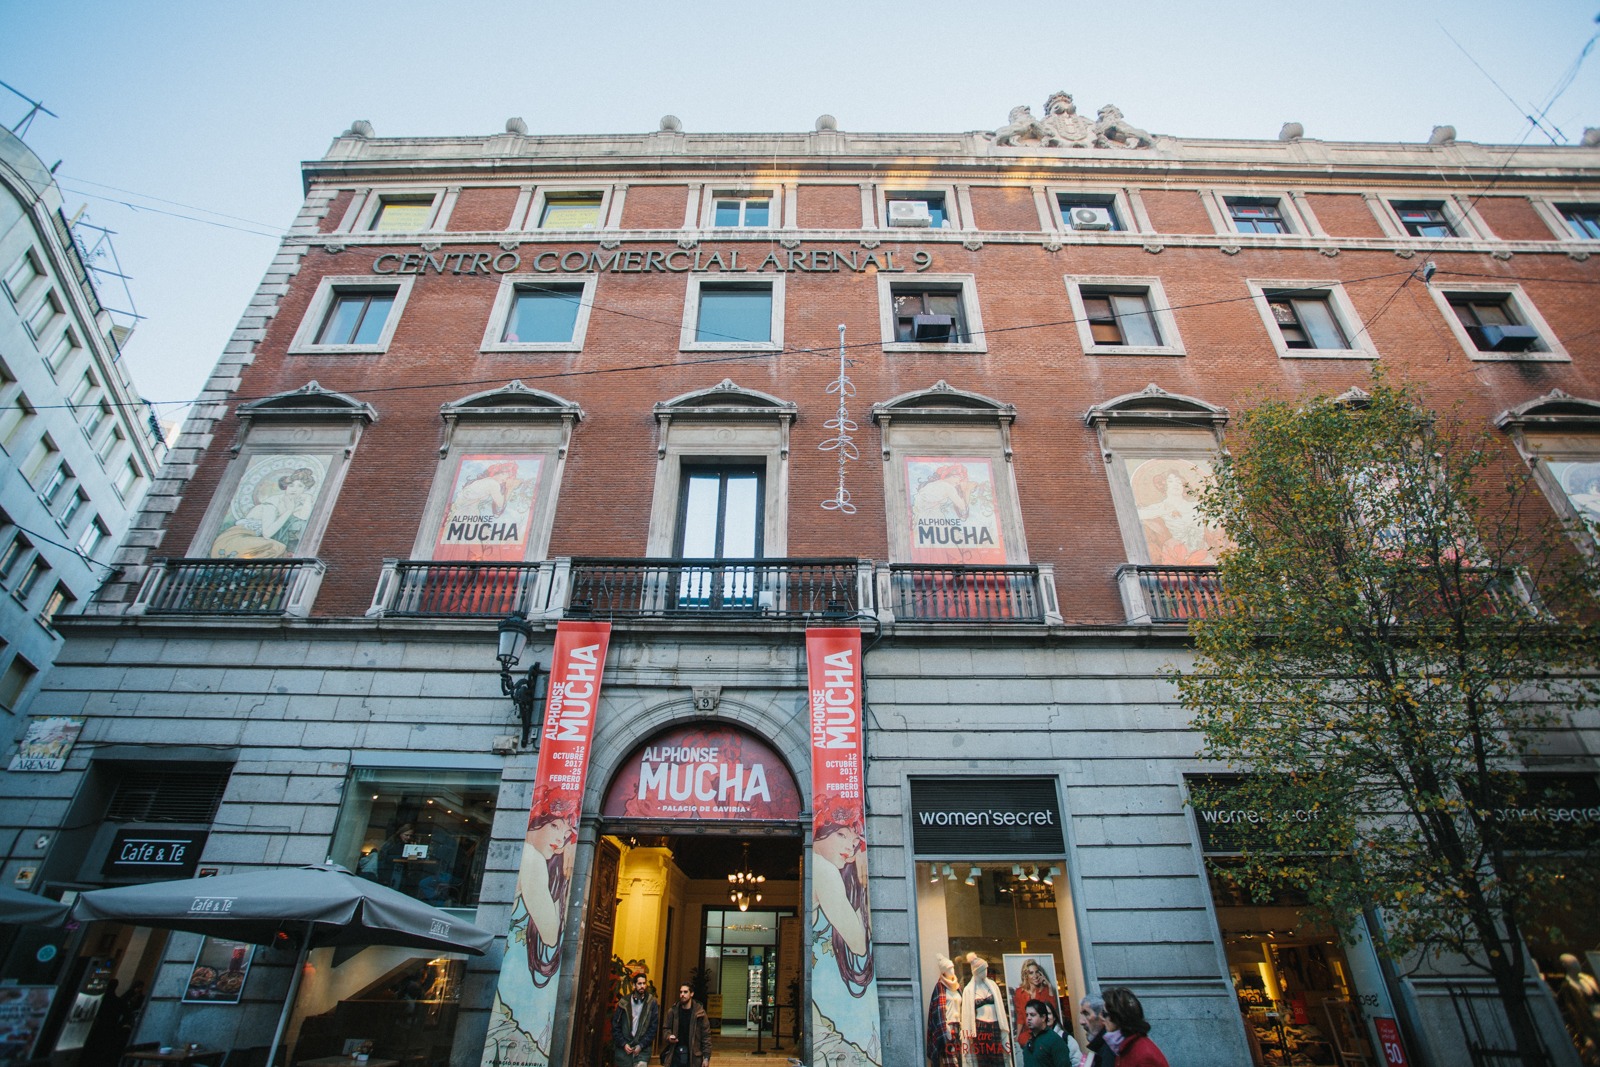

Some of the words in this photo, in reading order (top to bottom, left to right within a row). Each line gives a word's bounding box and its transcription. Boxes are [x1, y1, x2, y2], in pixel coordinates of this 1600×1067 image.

[372, 251, 521, 275] CENTRO
[533, 250, 749, 274] COMERCIAL
[757, 250, 904, 273] ARENAL
[913, 250, 933, 273] 9
[451, 515, 495, 523] ALPHONSE
[918, 518, 962, 526] ALPHONSE
[446, 522, 519, 542] MUCHA
[918, 526, 994, 545] MUCHA
[556, 643, 600, 742] MUCHA
[702, 697, 710, 708] 9
[824, 649, 857, 749] MUCHA
[545, 681, 566, 741] ALPHONSE
[812, 689, 826, 749] ALPHONSE
[552, 752, 584, 761] OCTUBRE
[641, 746, 719, 763] ALPHONSE
[848, 753, 857, 761] 12
[14, 759, 58, 770] ARENAL
[564, 760, 583, 768] 2017
[825, 760, 858, 768] OCTUBRE
[572, 768, 582, 776] 25
[839, 768, 858, 776] 2017
[549, 774, 581, 783] FEBRERO
[637, 762, 771, 802] MUCHA
[561, 783, 580, 791] 2018
[826, 783, 859, 791] FEBRERO
[840, 791, 859, 799] 2018
[919, 809, 1054, 826] women'secret
[120, 843, 155, 861] Café
[155, 848, 165, 861] &
[169, 844, 186, 862] Té
[190, 899, 214, 911] Café
[221, 899, 233, 912] Té
[962, 1029, 976, 1041] We
[977, 1031, 993, 1041] are
[945, 1041, 1013, 1055] CHRISTMAS
[1384, 1042, 1403, 1064] 50
